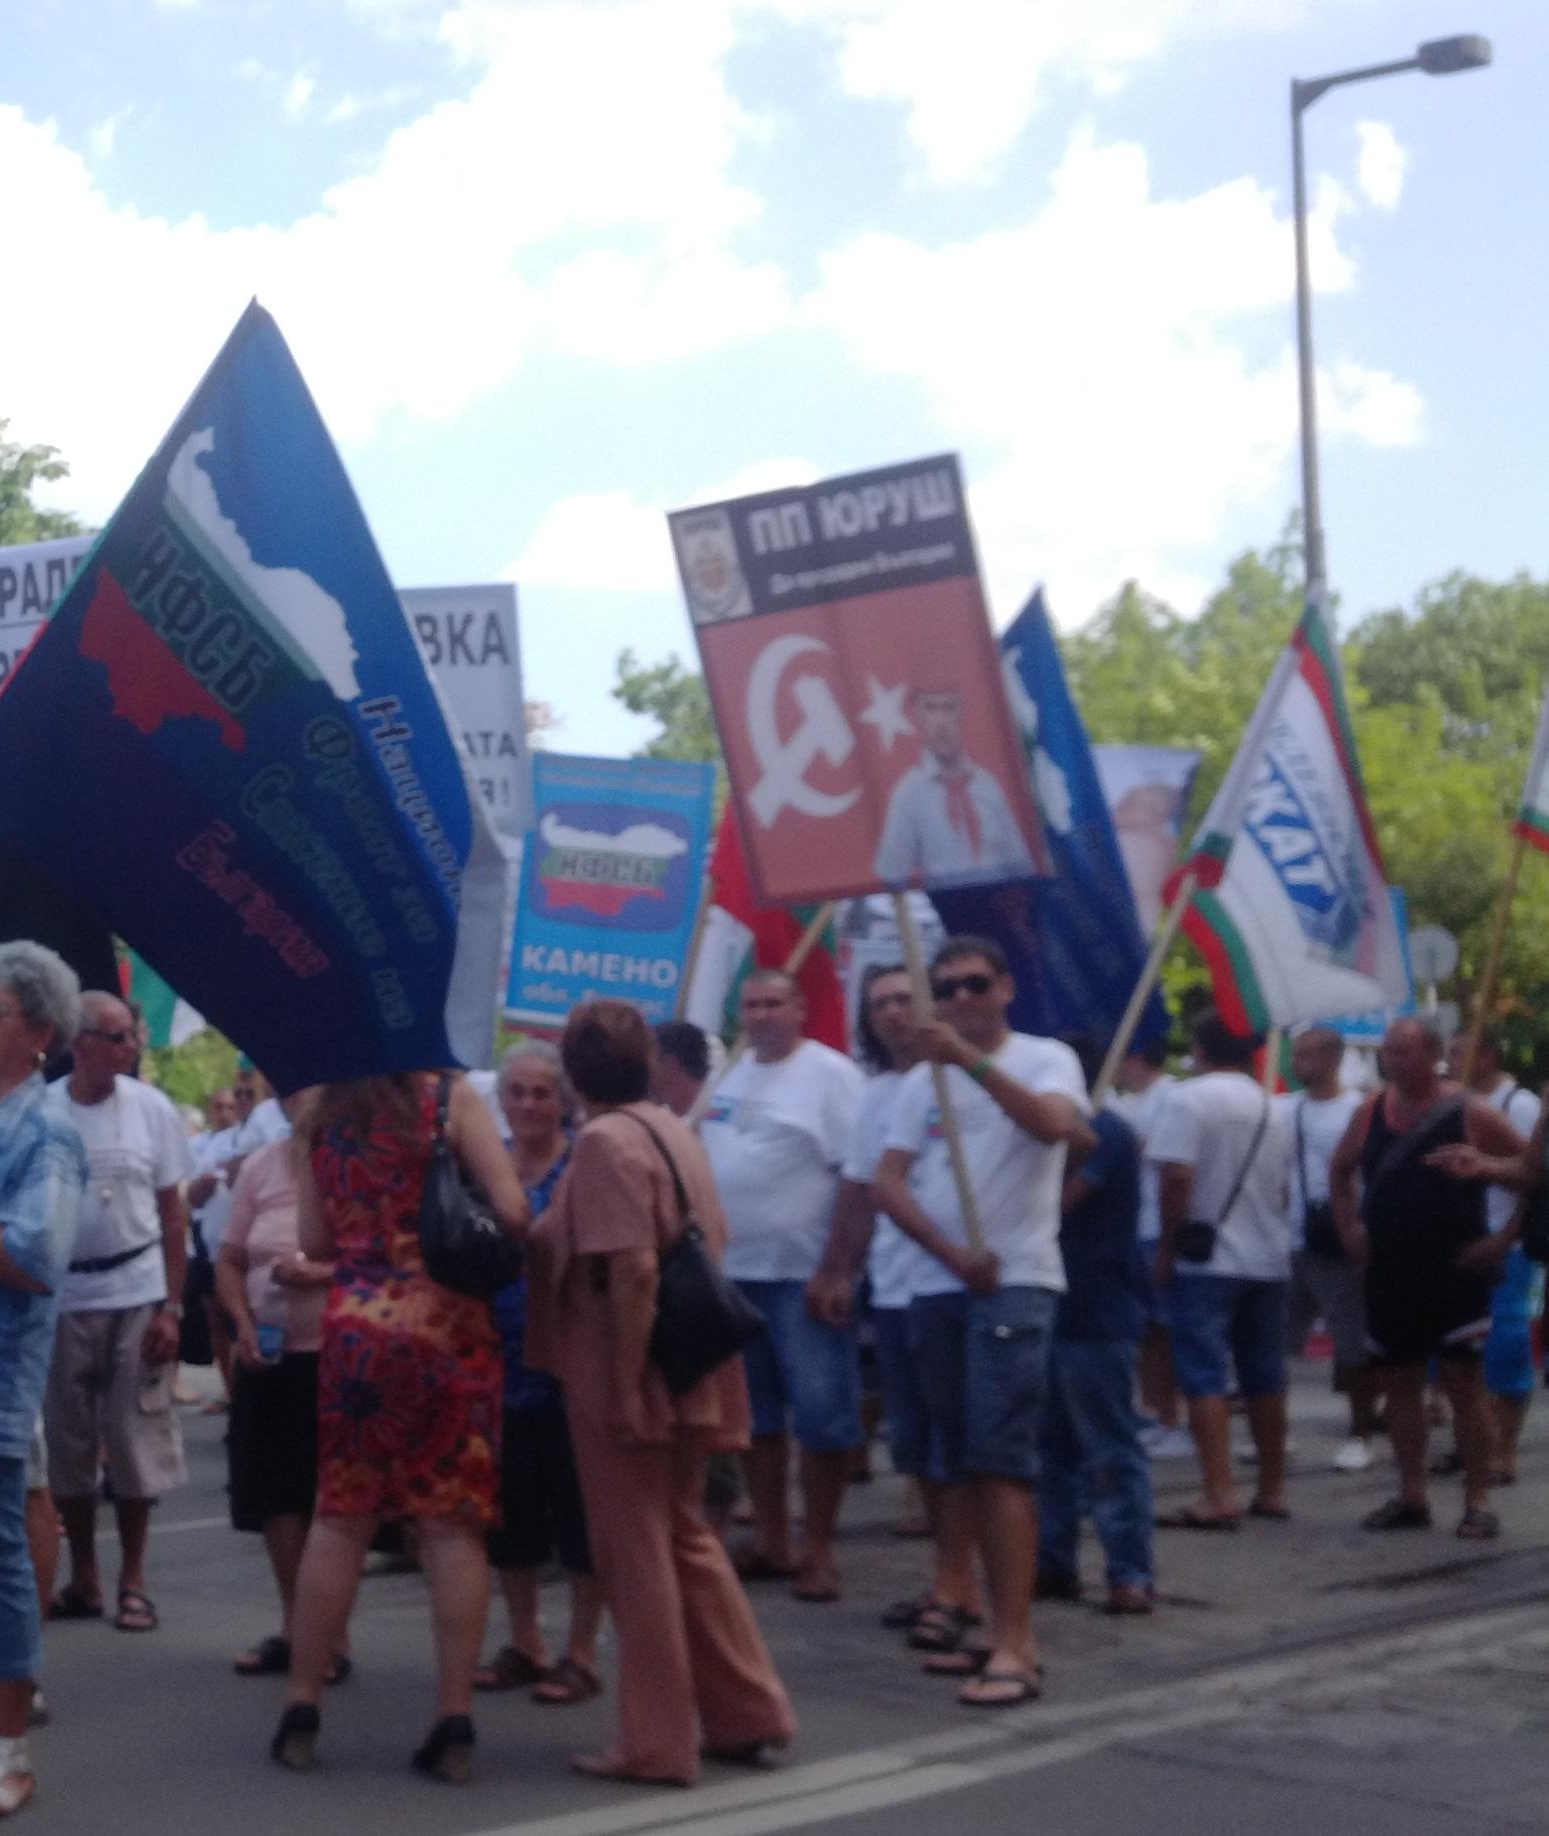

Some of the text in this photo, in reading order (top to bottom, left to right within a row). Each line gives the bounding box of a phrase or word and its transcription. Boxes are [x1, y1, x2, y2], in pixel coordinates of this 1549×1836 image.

[750, 466, 956, 555] ПП ЮРУШ
[130, 524, 278, 716] НФСБ
[522, 944, 678, 989] КАМЕНО
